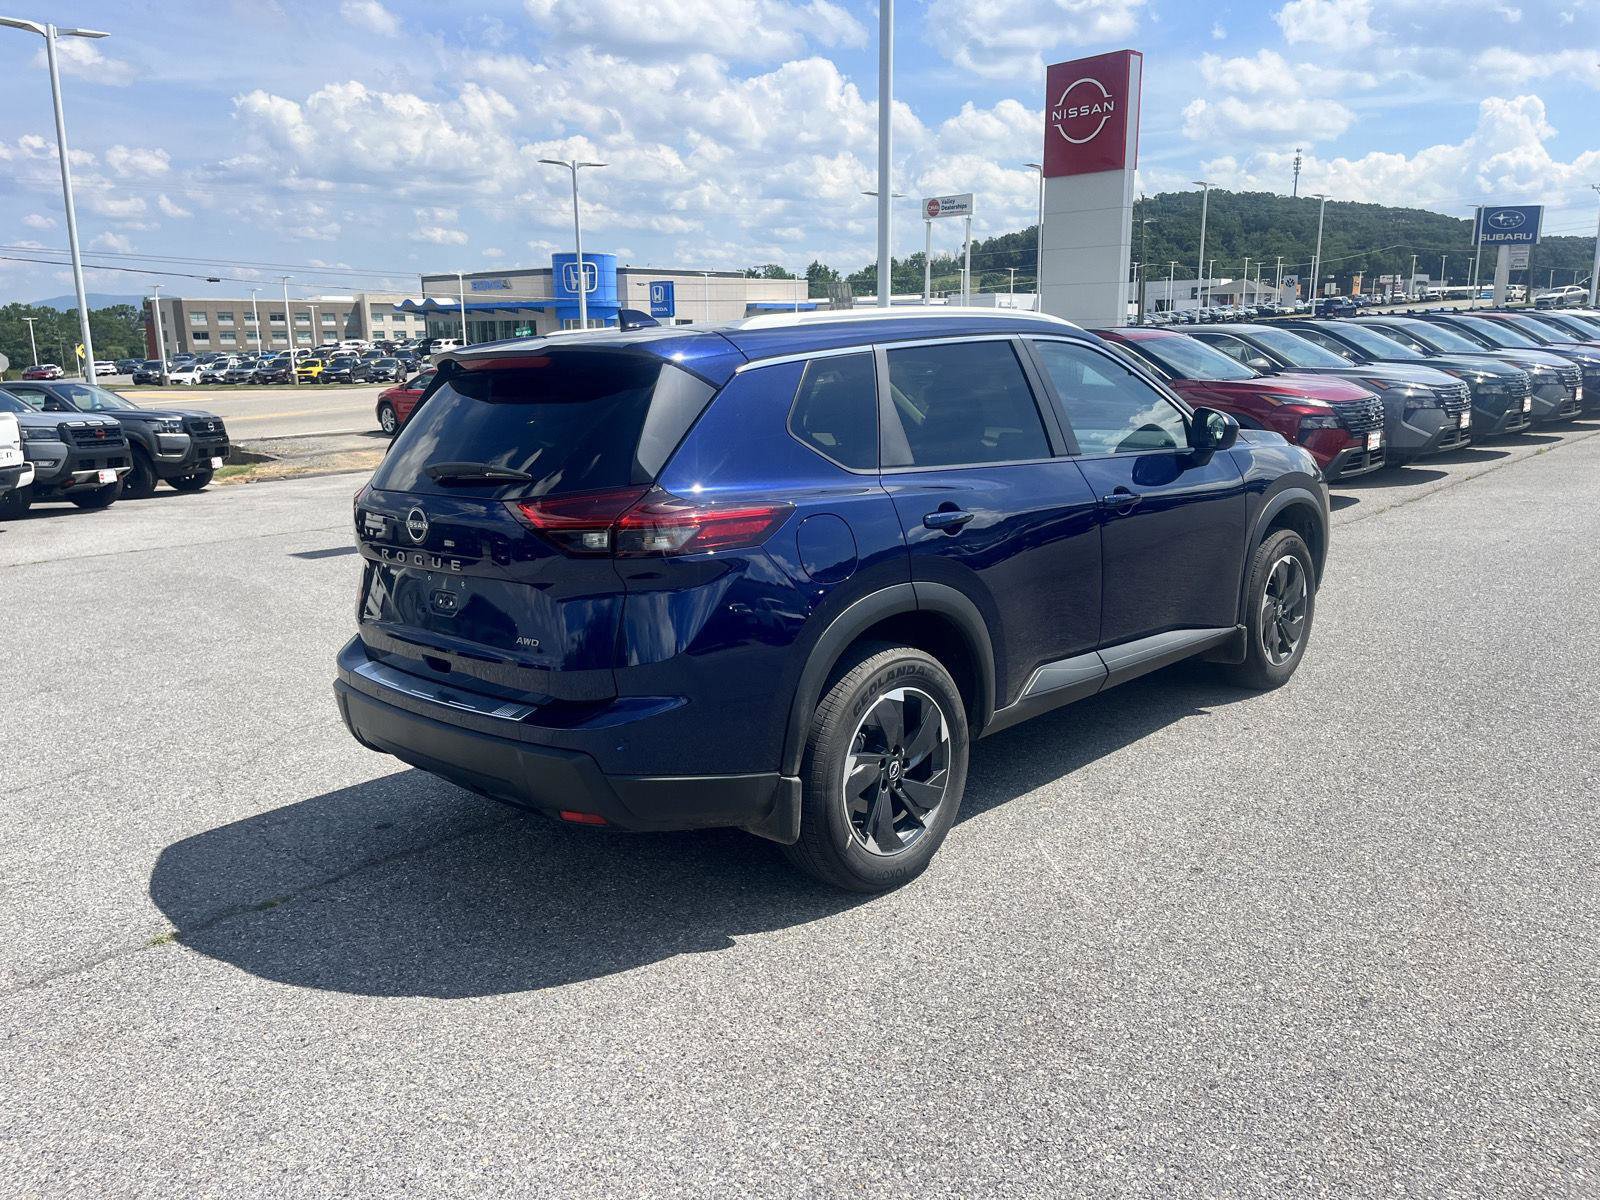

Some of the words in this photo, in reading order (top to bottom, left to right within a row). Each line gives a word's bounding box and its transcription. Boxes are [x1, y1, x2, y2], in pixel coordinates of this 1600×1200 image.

[1052, 101, 1115, 121] NISSAN
[1481, 233, 1532, 241] SUBARU
[381, 548, 463, 572] ROGUE
[516, 636, 539, 647] AWD
